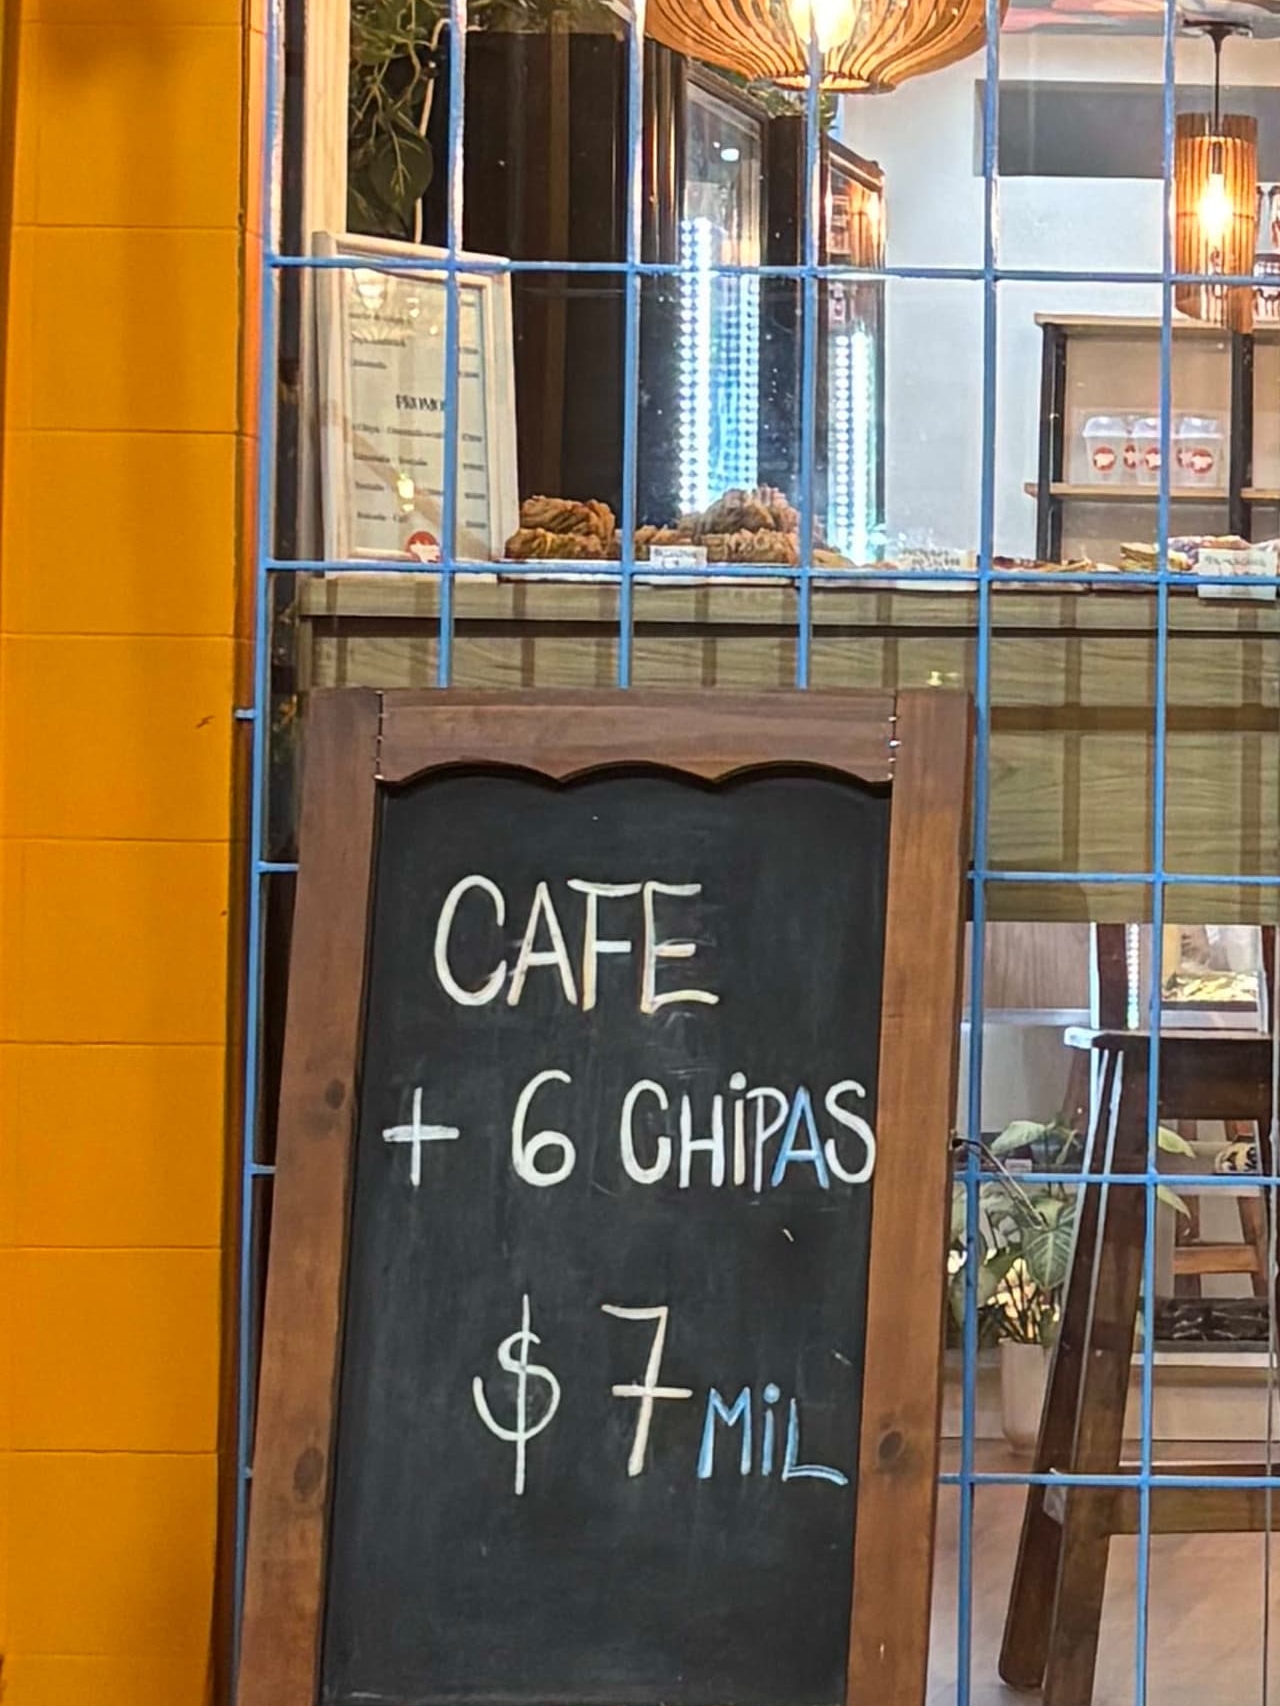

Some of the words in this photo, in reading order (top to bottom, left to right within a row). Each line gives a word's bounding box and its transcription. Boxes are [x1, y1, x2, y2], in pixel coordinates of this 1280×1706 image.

[434, 874, 719, 1013] CAFE
[511, 1070, 575, 1187] 6
[472, 1293, 561, 1496] $
[601, 1305, 693, 1477] 7
